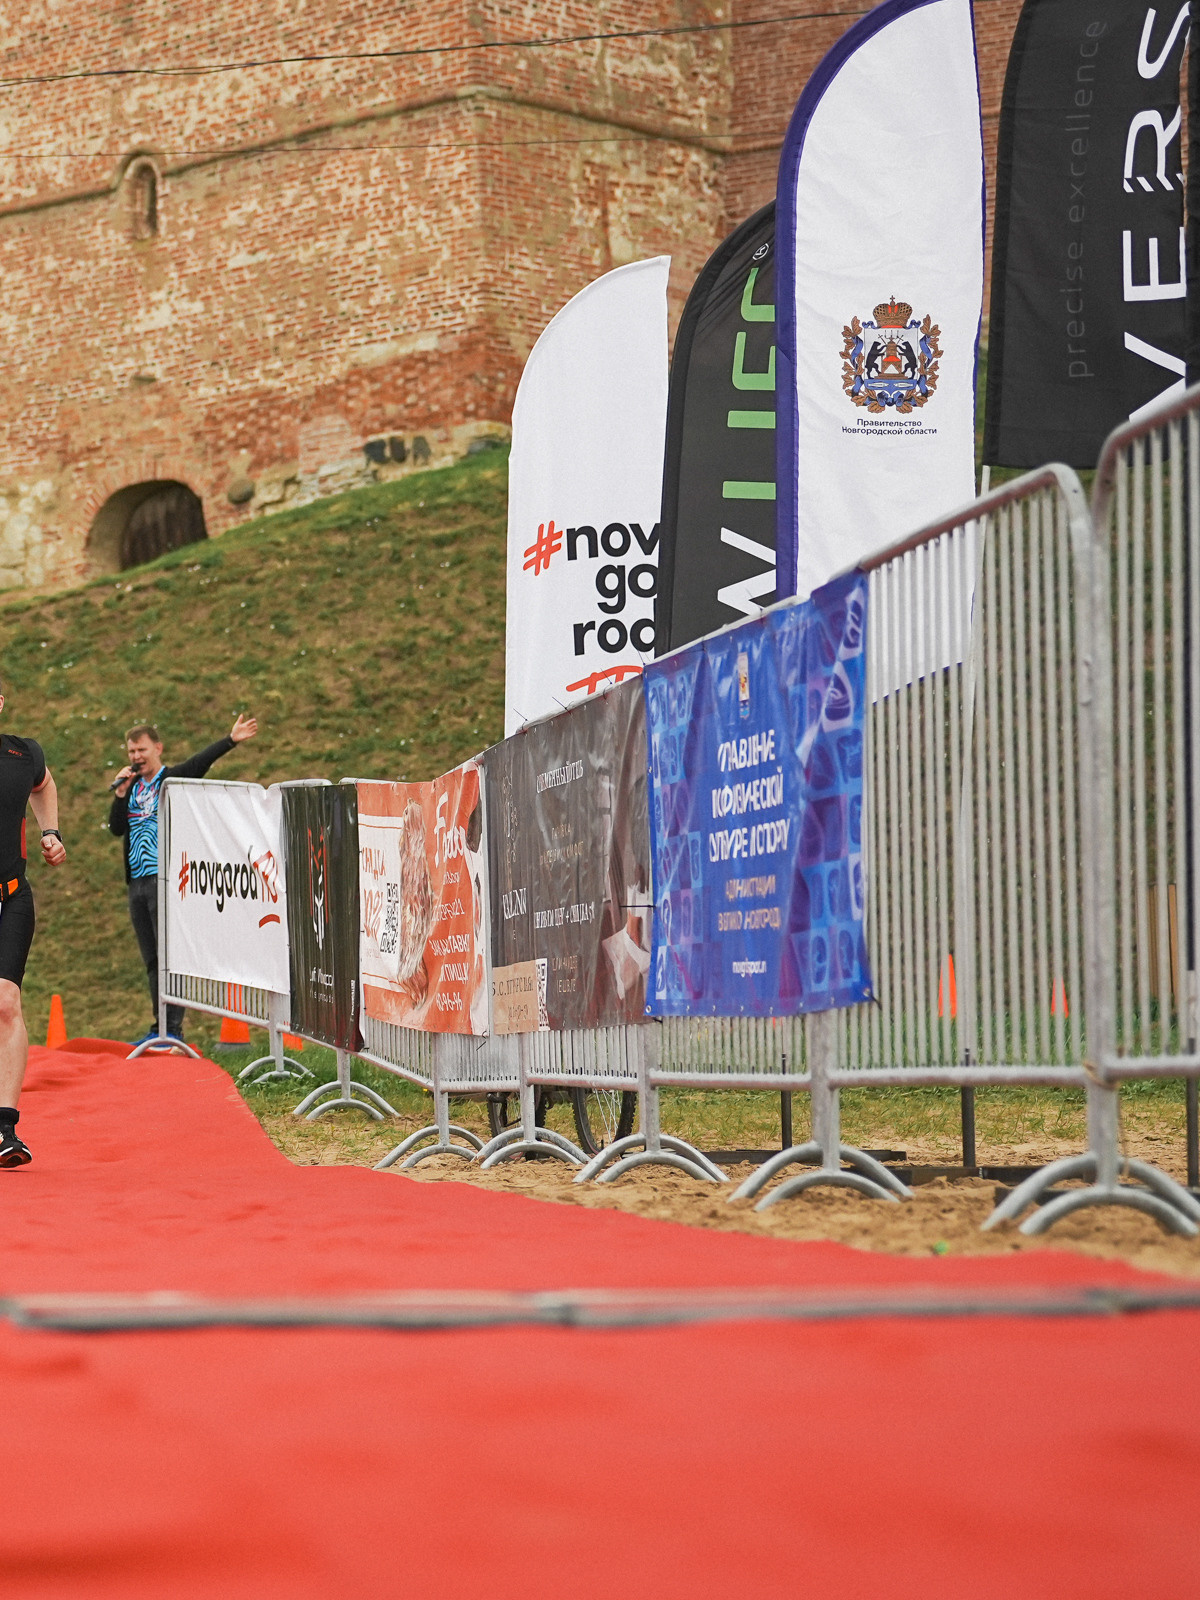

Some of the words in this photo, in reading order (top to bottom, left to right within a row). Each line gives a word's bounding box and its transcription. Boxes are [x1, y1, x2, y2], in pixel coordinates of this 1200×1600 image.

[1065, 20, 1107, 224] excellence
[1059, 244, 1095, 380] precise
[842, 426, 903, 436] Новгородской
[904, 427, 938, 435] области
[856, 418, 922, 428] Правительство
[523, 520, 660, 577] #nov
[595, 563, 659, 615] go
